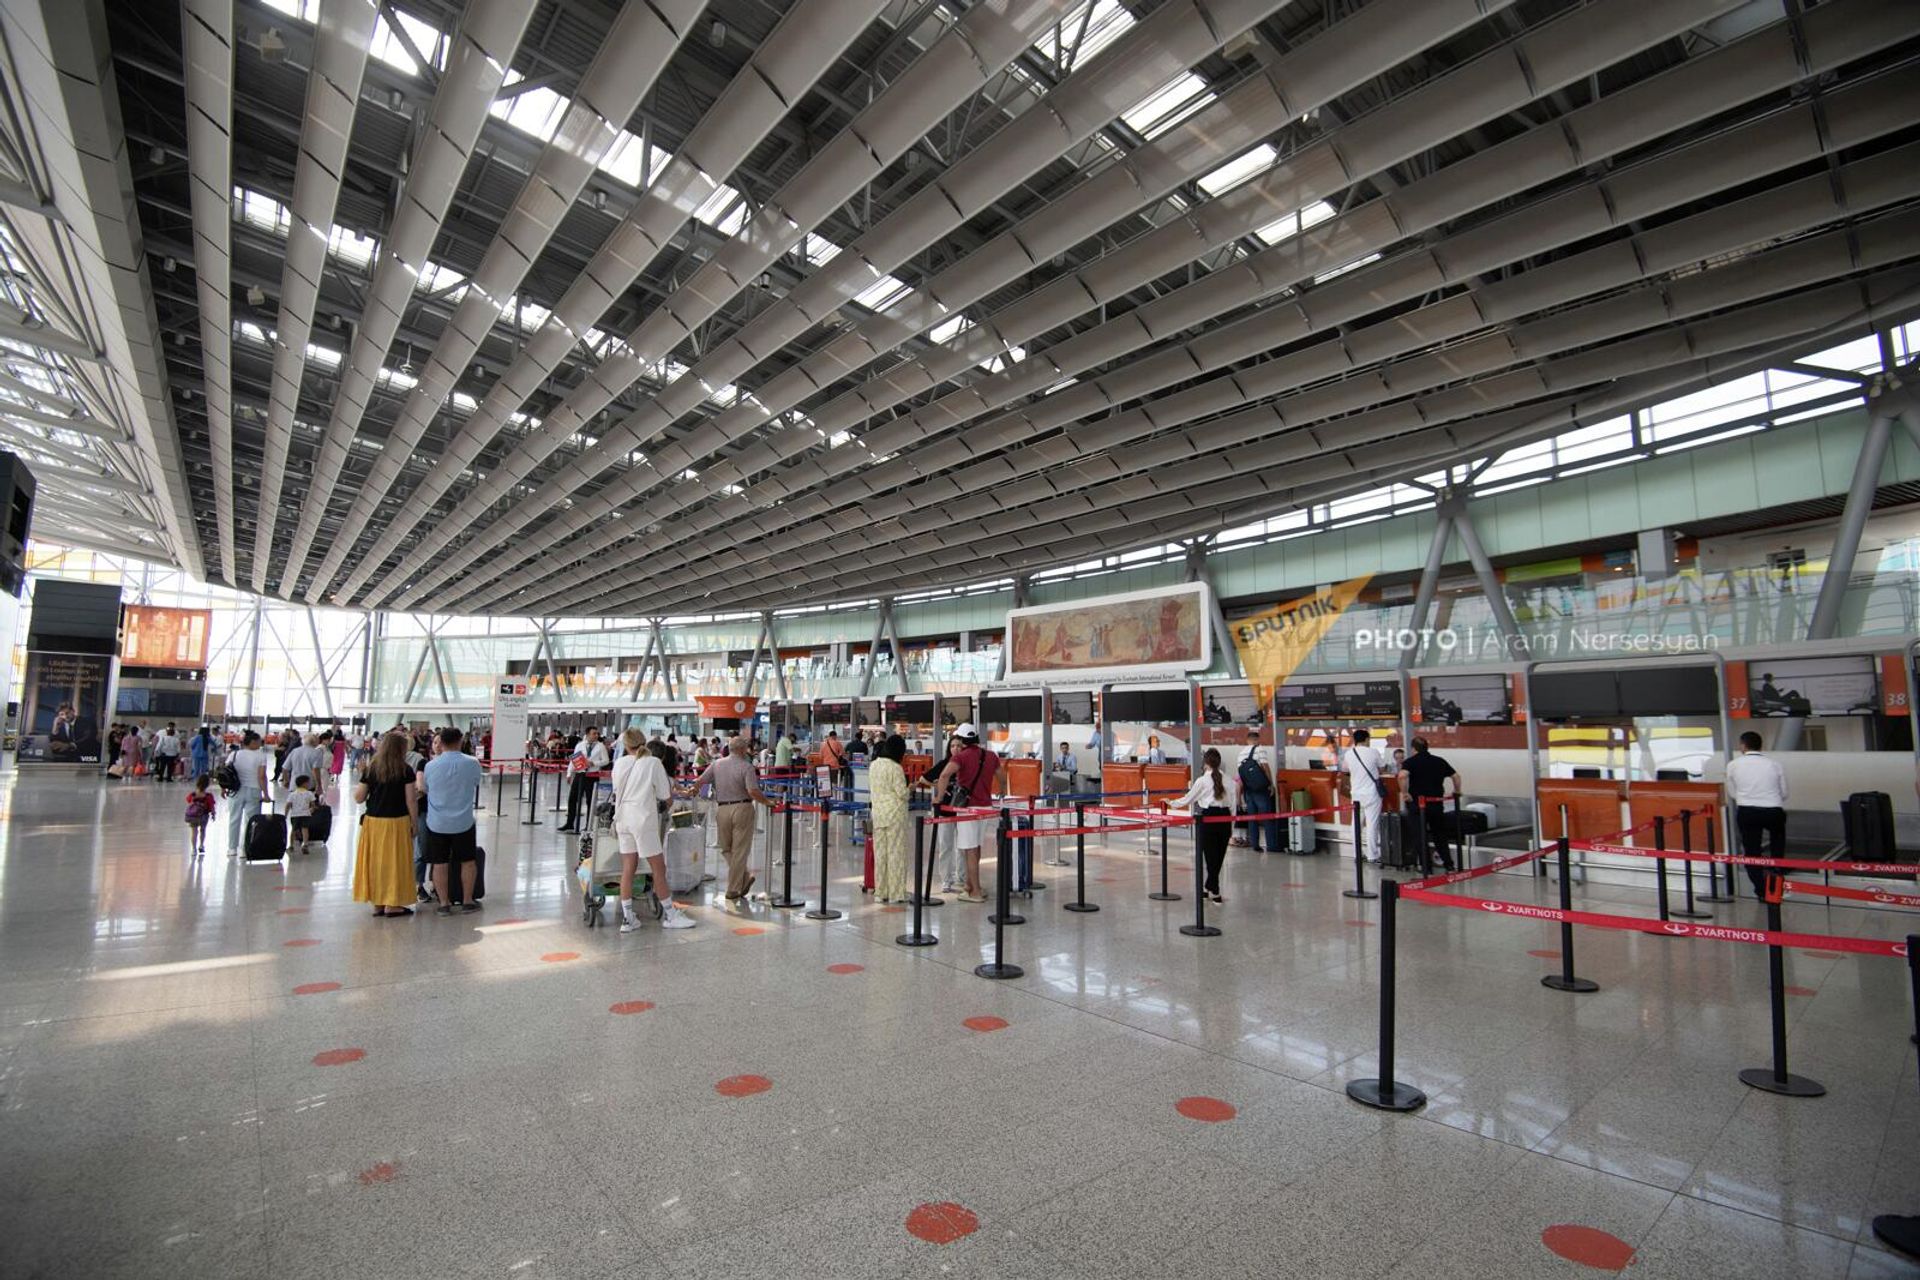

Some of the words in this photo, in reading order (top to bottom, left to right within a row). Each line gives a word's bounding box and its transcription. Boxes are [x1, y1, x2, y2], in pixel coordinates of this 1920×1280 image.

[1730, 697, 1747, 710] 37
[1887, 692, 1906, 707] 38
[1730, 856, 1776, 867] ZVARTNOTS
[1873, 864, 1920, 874] ZVARTNOT
[1506, 904, 1563, 920] ZVARTNOTS
[1694, 926, 1765, 943] ZVARTNOTS
